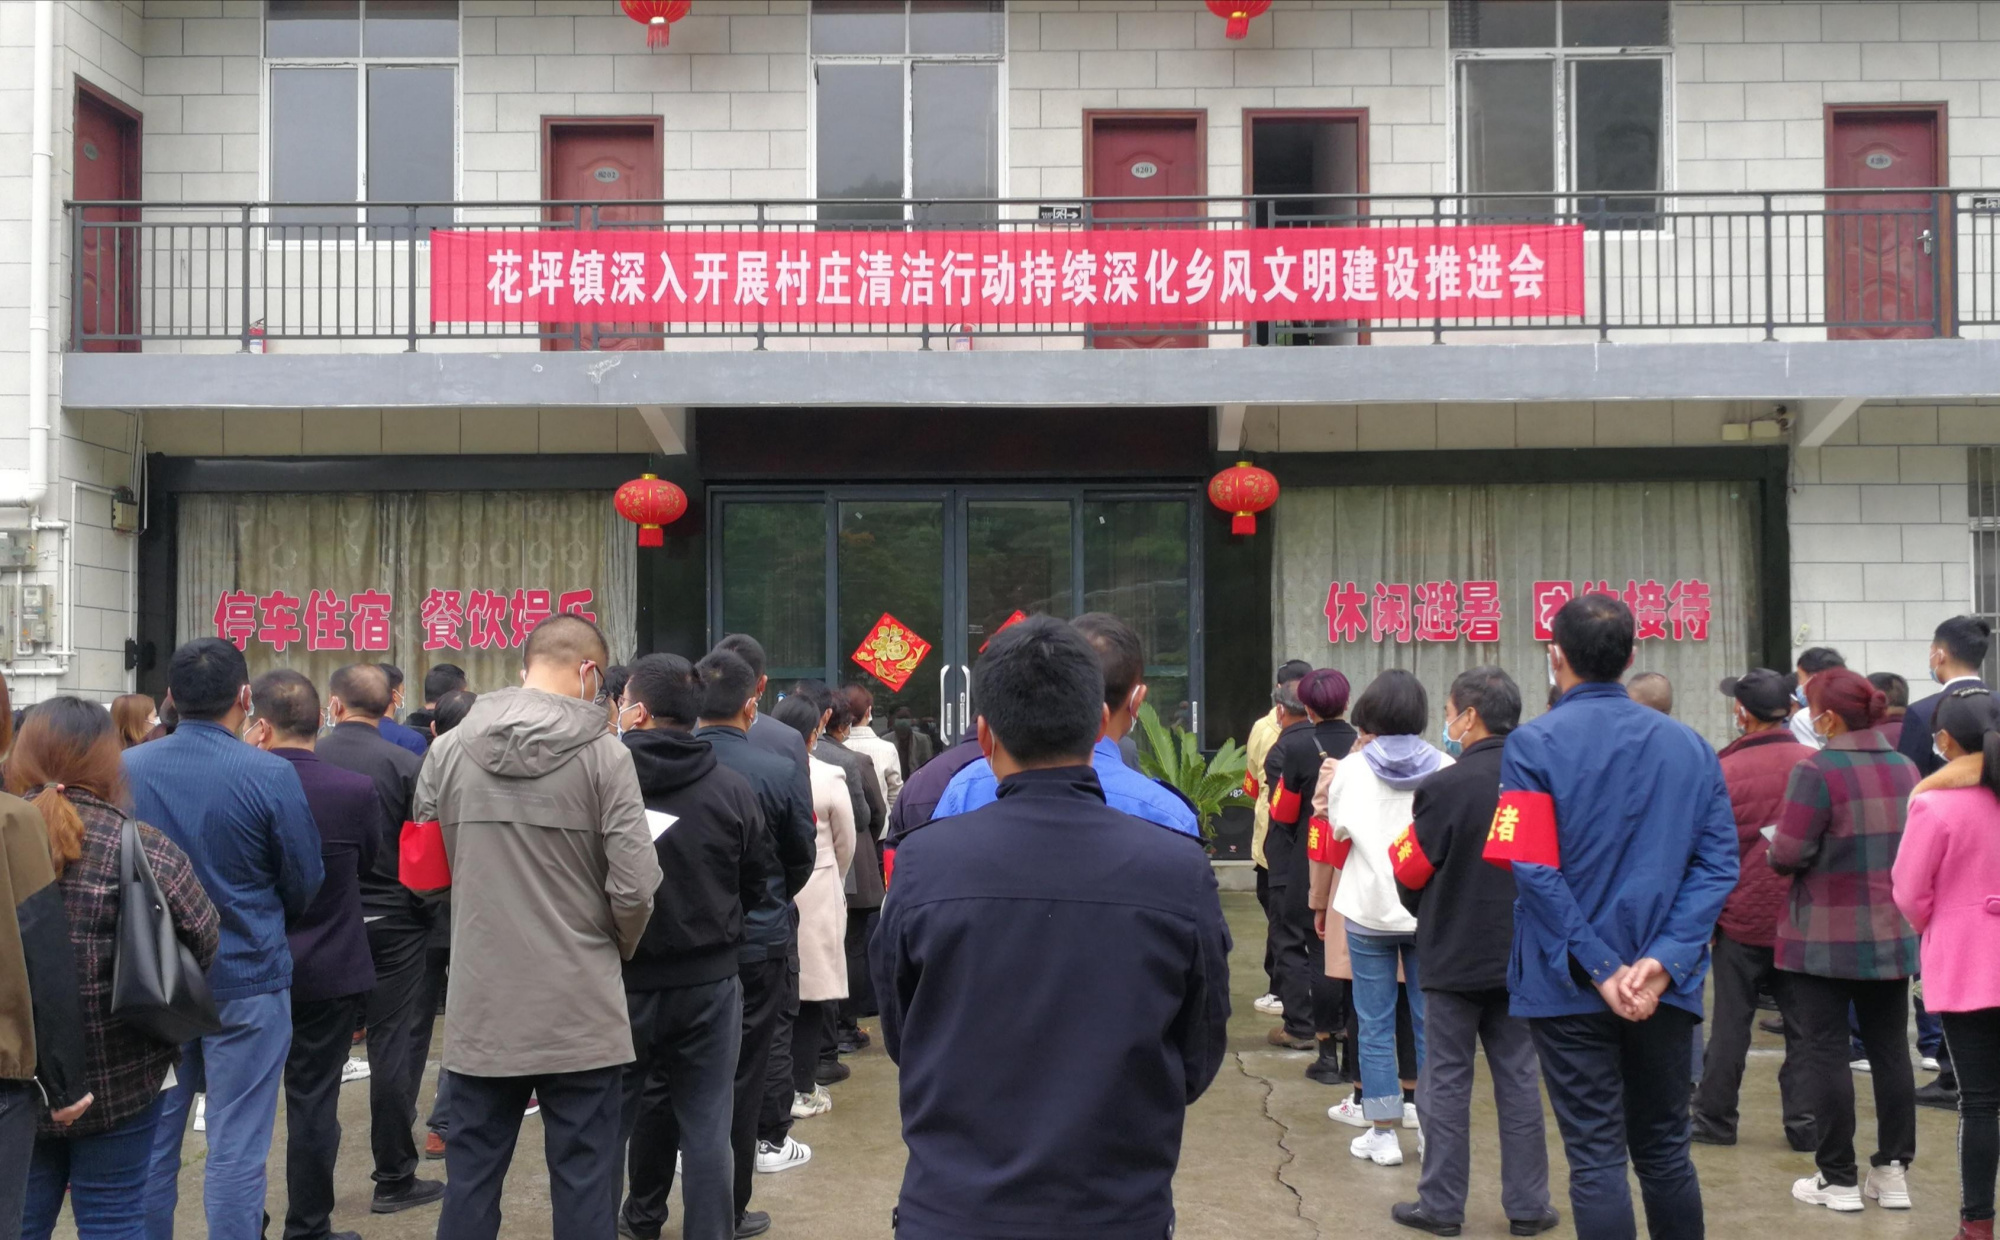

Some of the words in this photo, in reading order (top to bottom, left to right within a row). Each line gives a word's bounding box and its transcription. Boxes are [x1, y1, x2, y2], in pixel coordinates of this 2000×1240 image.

[487, 244, 1545, 305] 花坪镇深入开展村庄清洁行动持续深化乡风文明建设推进会
[214, 589, 392, 652] 停车住宿
[1324, 580, 1502, 643] 休闲避暑
[1533, 579, 1711, 641] 团接待
[871, 624, 910, 662] 福
[1487, 804, 1520, 842] 者
